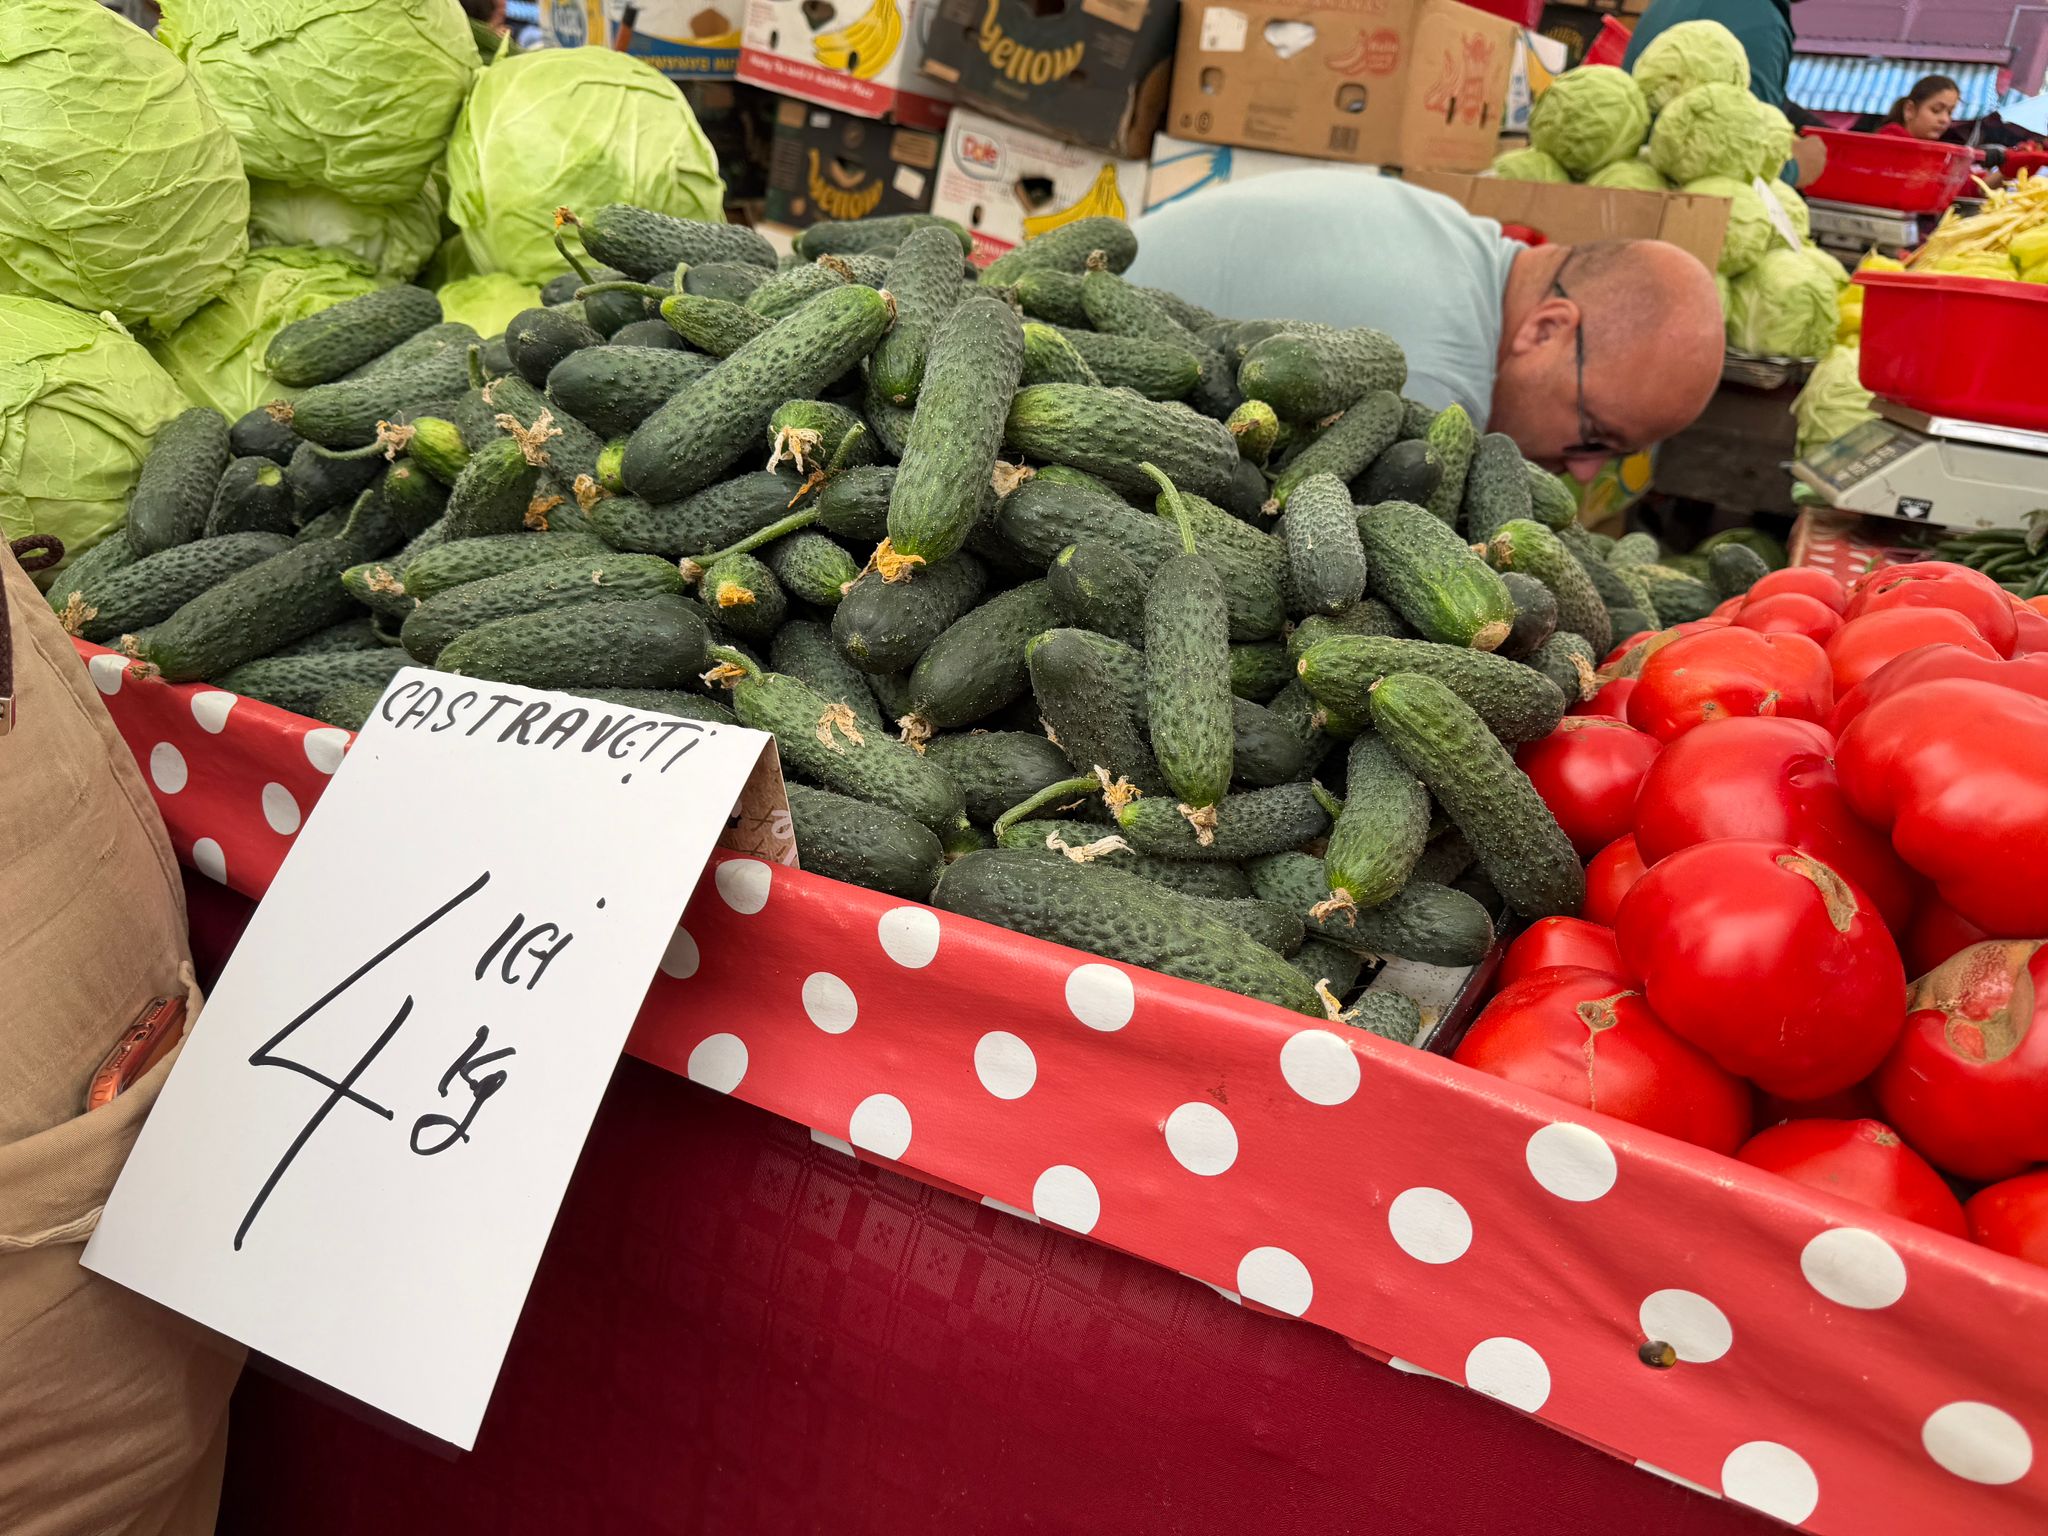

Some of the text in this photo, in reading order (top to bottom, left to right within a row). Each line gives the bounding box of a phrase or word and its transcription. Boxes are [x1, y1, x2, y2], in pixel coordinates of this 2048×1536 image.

[979, 0, 1085, 85] yellow
[808, 148, 884, 220] yellow
[962, 135, 998, 162] Dole
[234, 871, 490, 1251] 4
